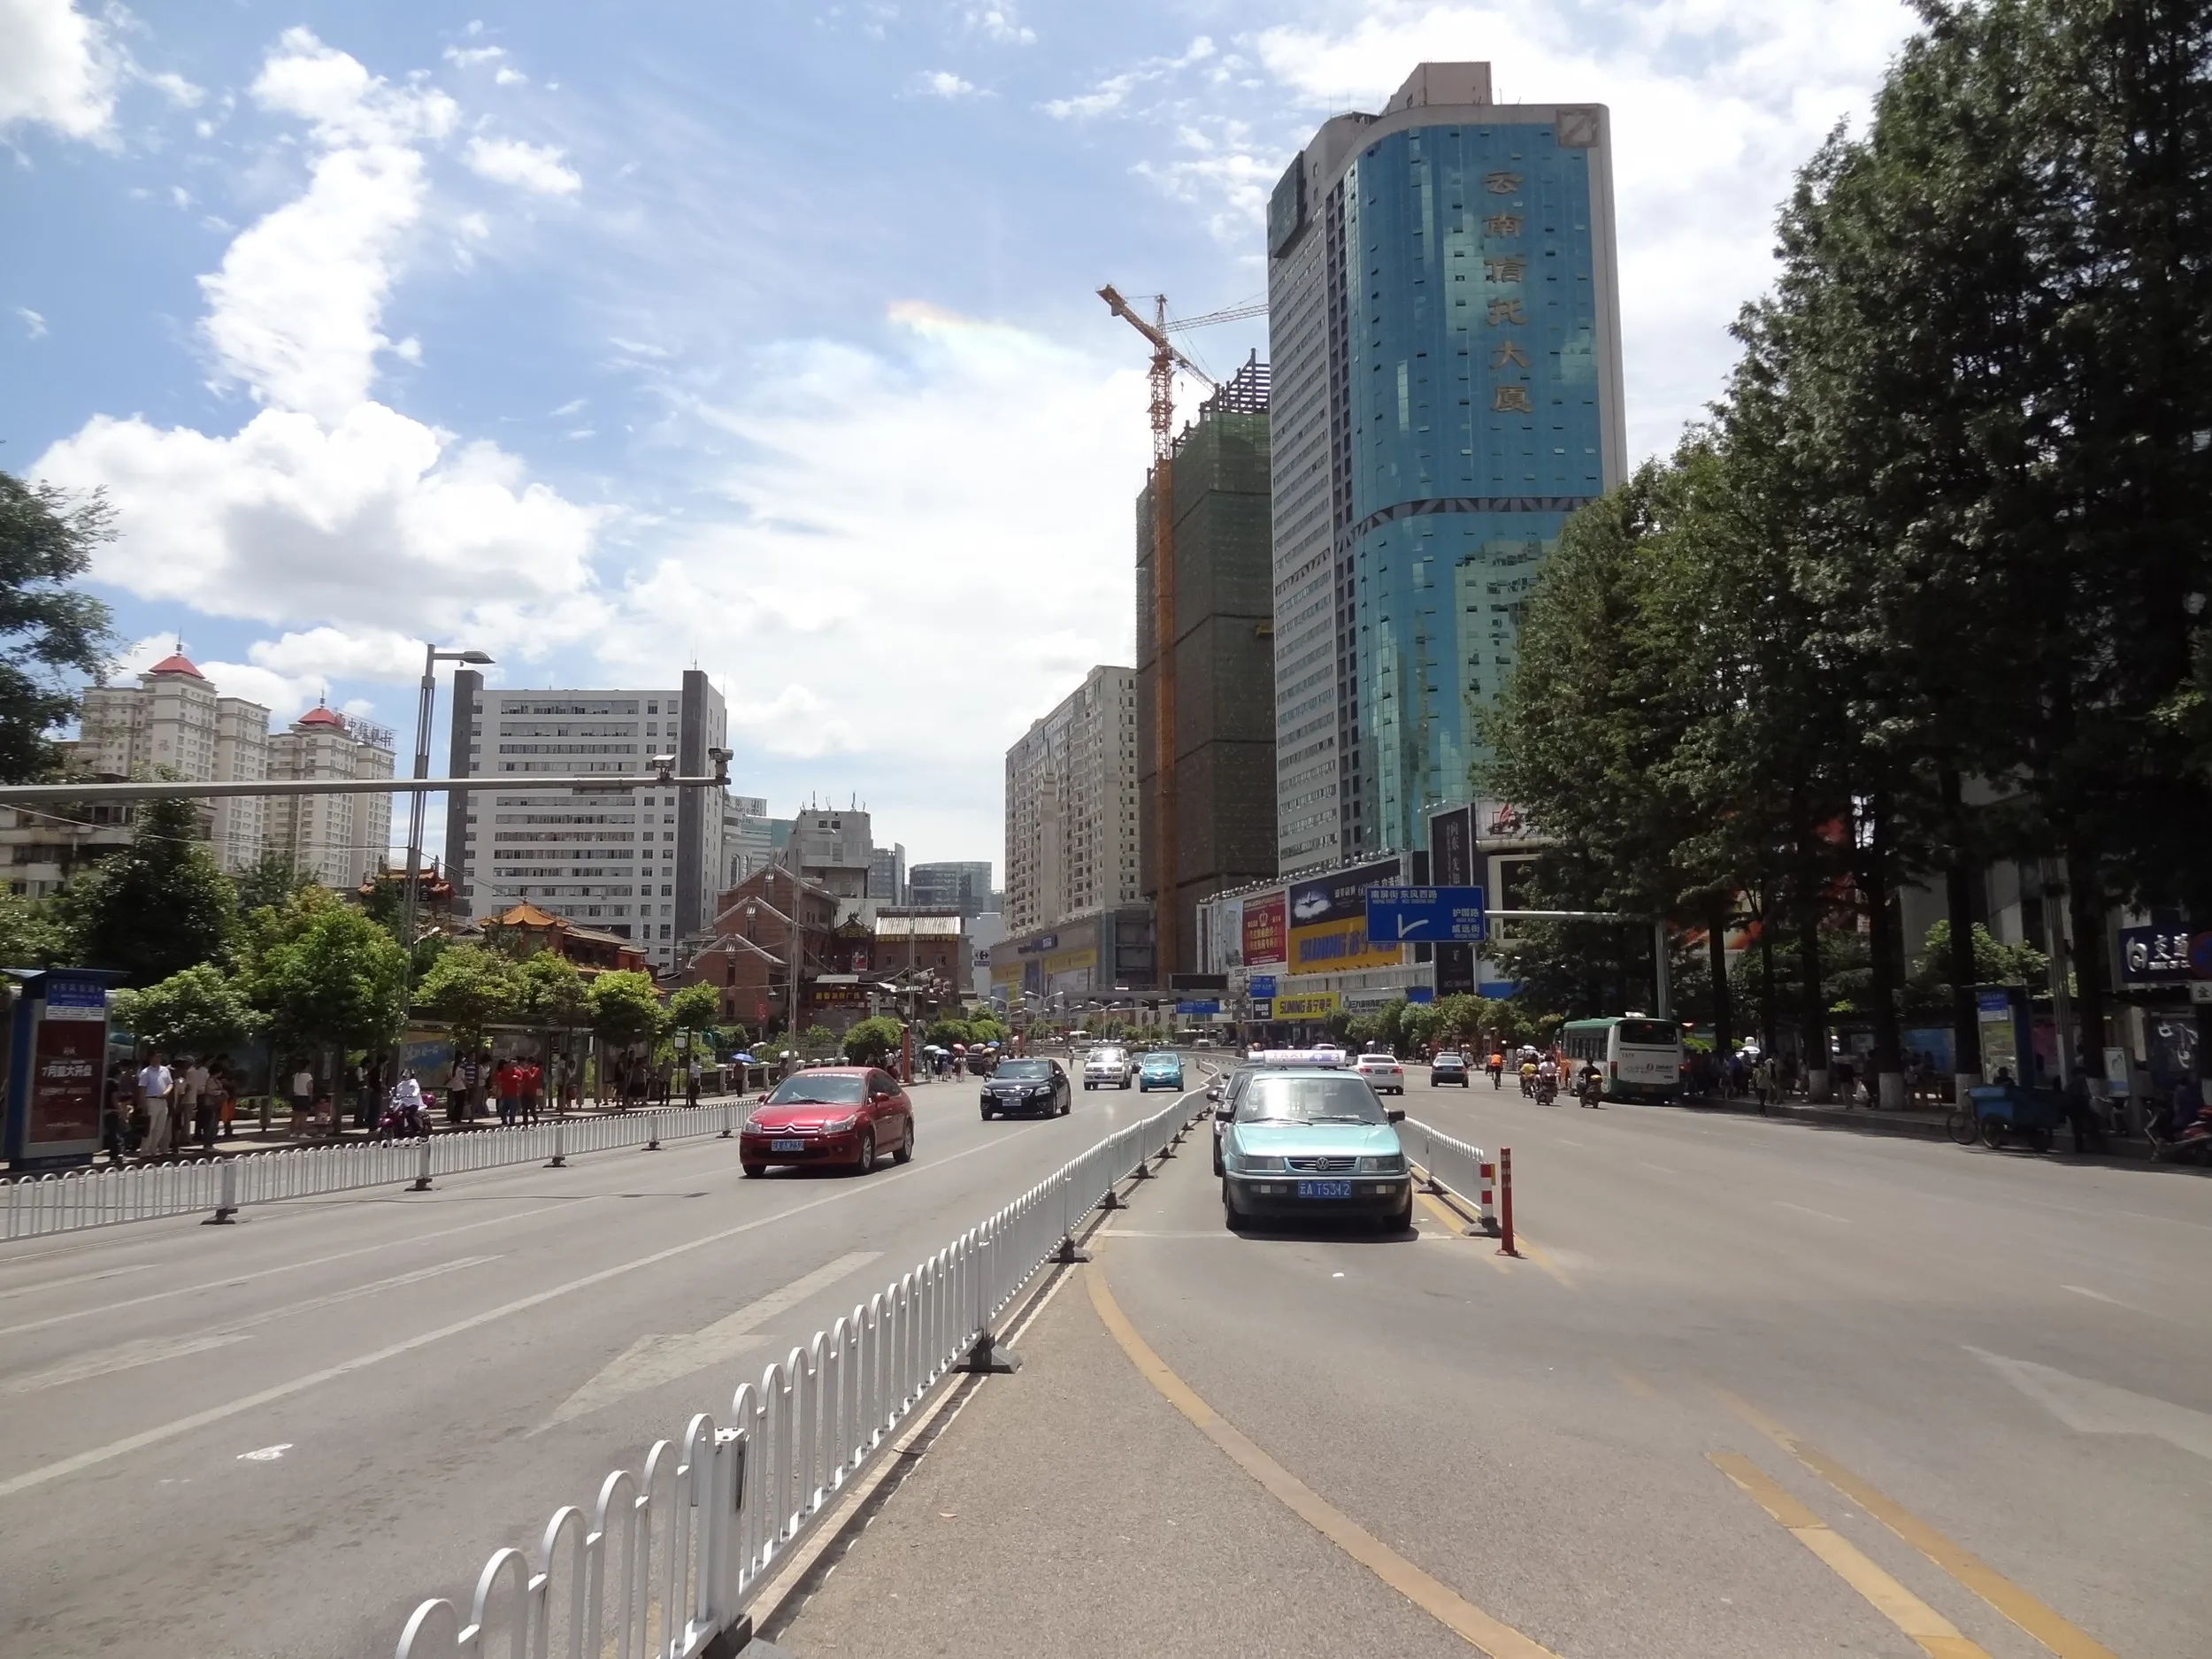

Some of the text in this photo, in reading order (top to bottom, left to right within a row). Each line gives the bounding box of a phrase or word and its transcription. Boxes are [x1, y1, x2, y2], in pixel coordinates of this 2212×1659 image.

[1401, 890, 1437, 899] 东风西路
[1452, 908, 1479, 918] 护国路
[1279, 999, 1306, 1014] SUNING
